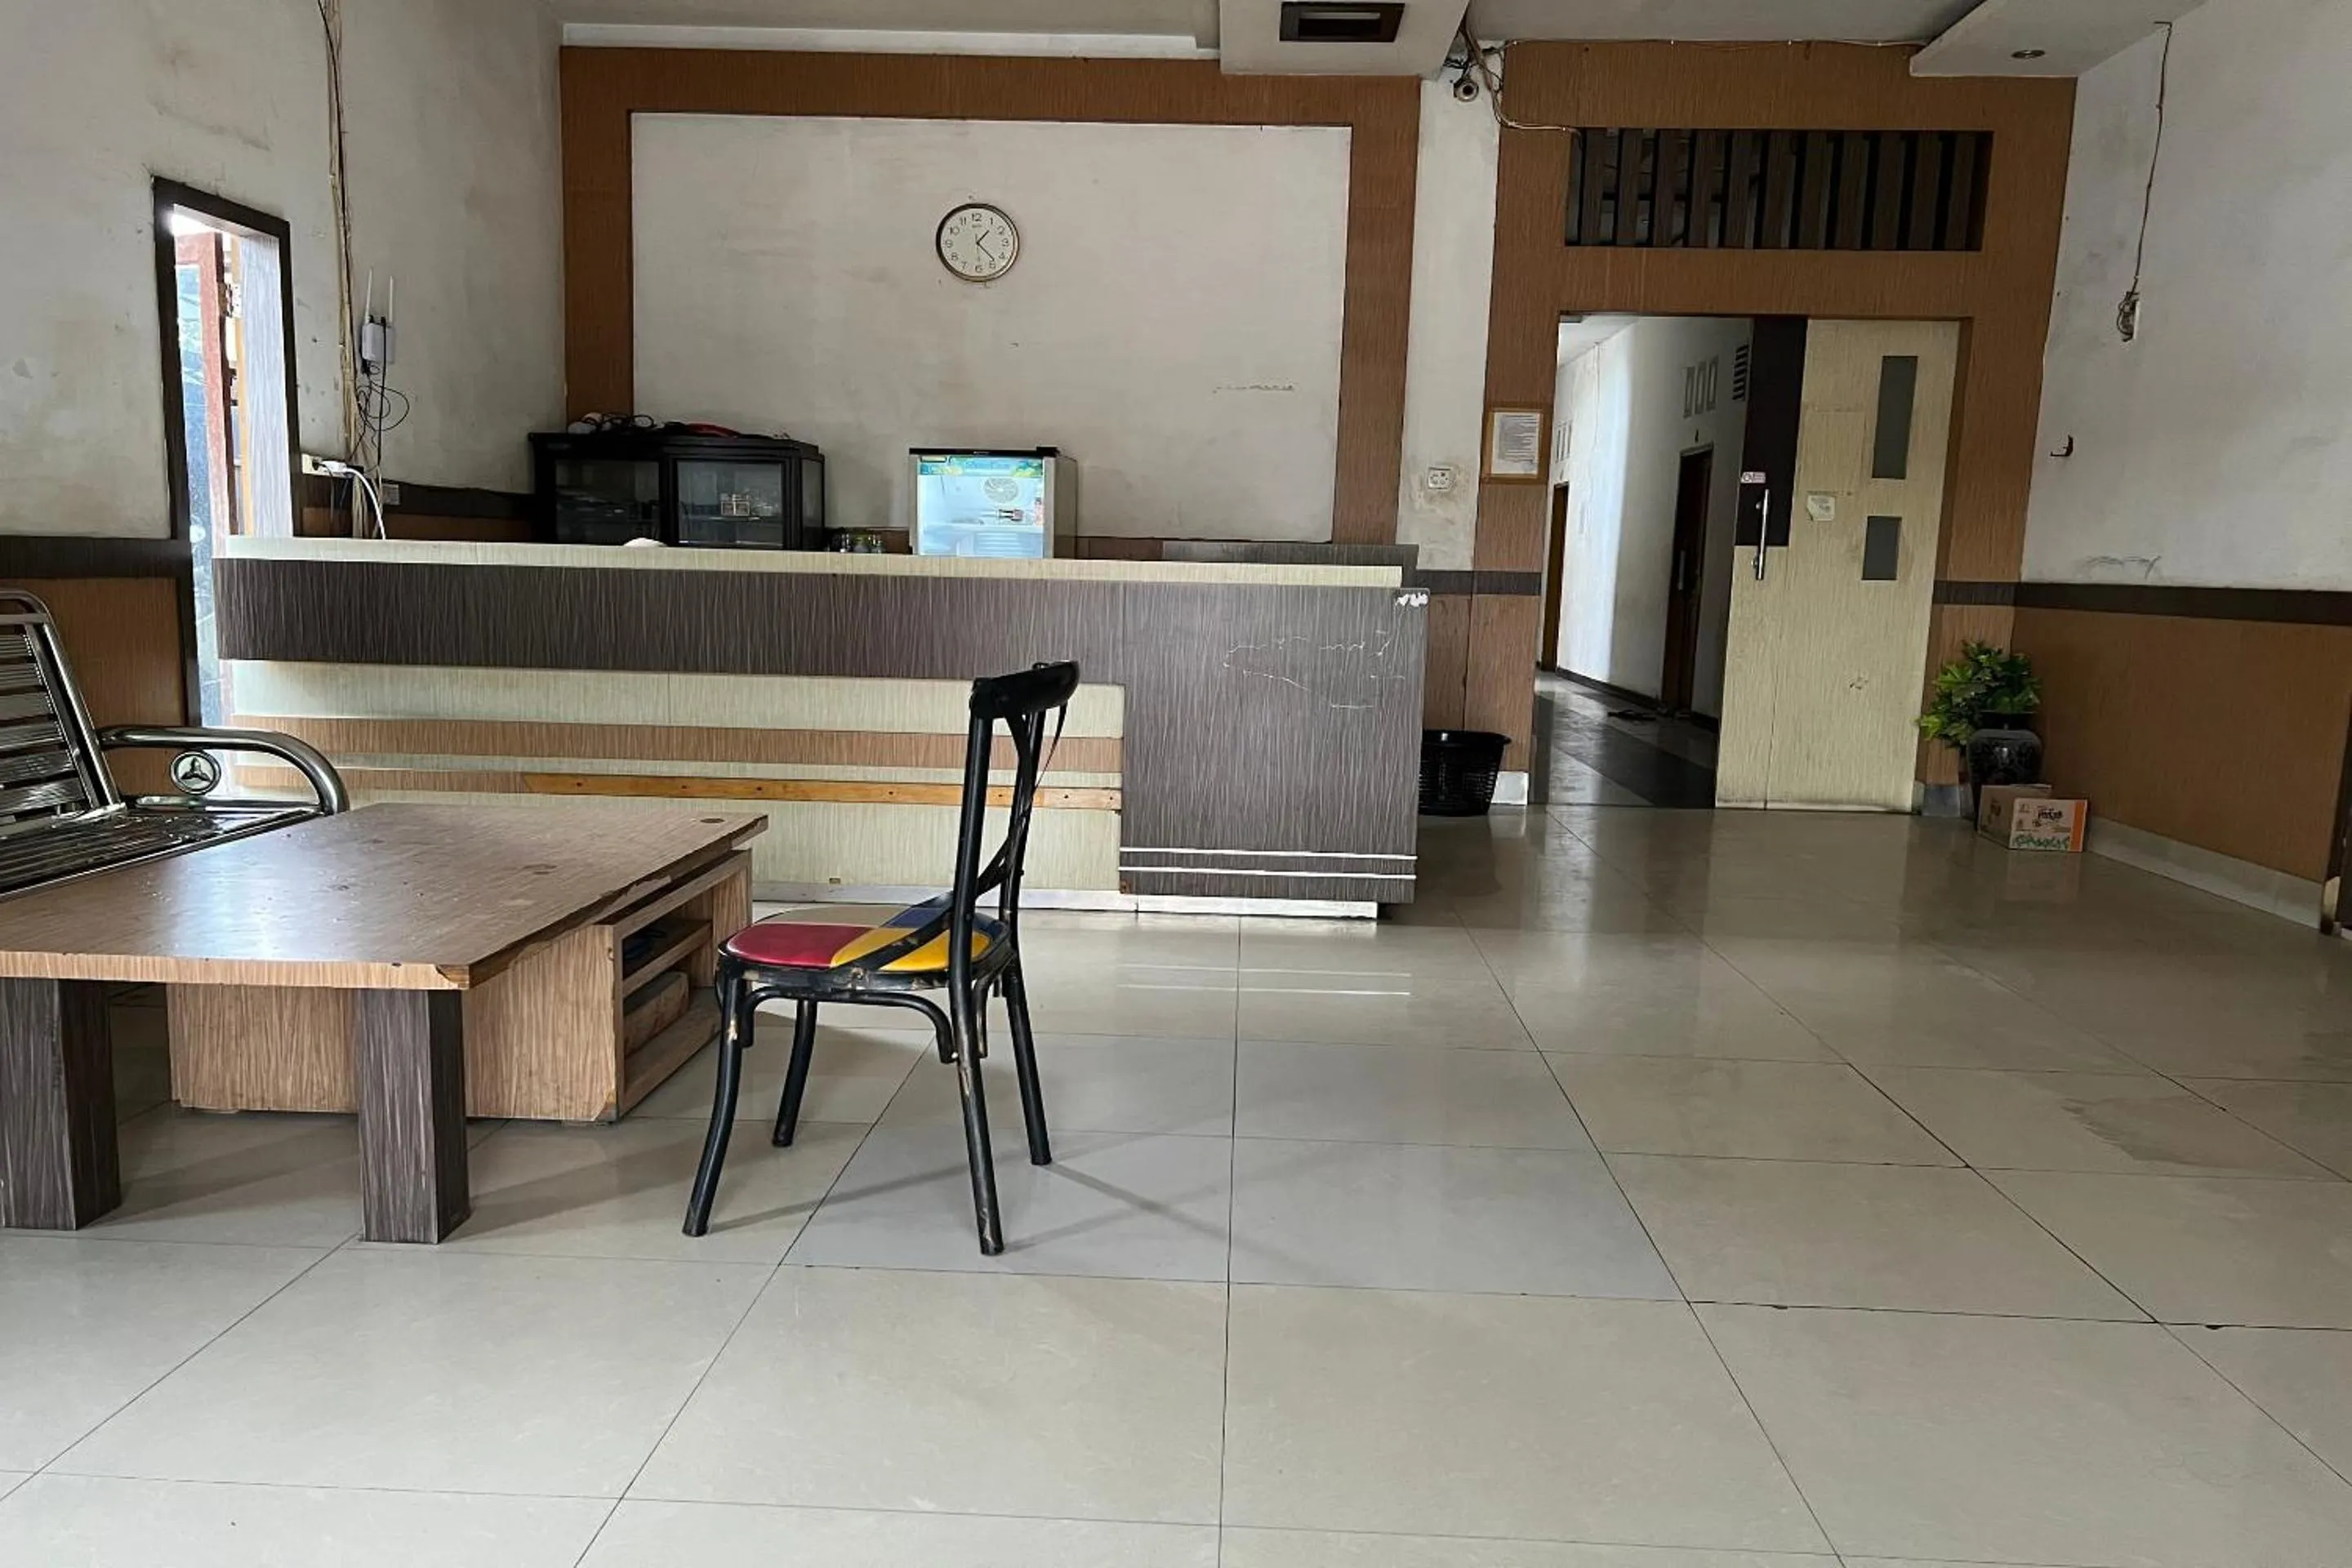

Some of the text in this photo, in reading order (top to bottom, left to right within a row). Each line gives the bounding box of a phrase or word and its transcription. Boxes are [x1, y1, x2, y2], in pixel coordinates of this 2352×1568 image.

[960, 217, 967, 225] 11
[972, 213, 982, 221] 12
[950, 226, 960, 235] 10
[997, 226, 1004, 234] 2
[945, 239, 952, 247] 9
[1002, 238, 1009, 247] 3
[951, 252, 959, 261] 8
[961, 261, 968, 270] 7
[975, 265, 982, 273] 6
